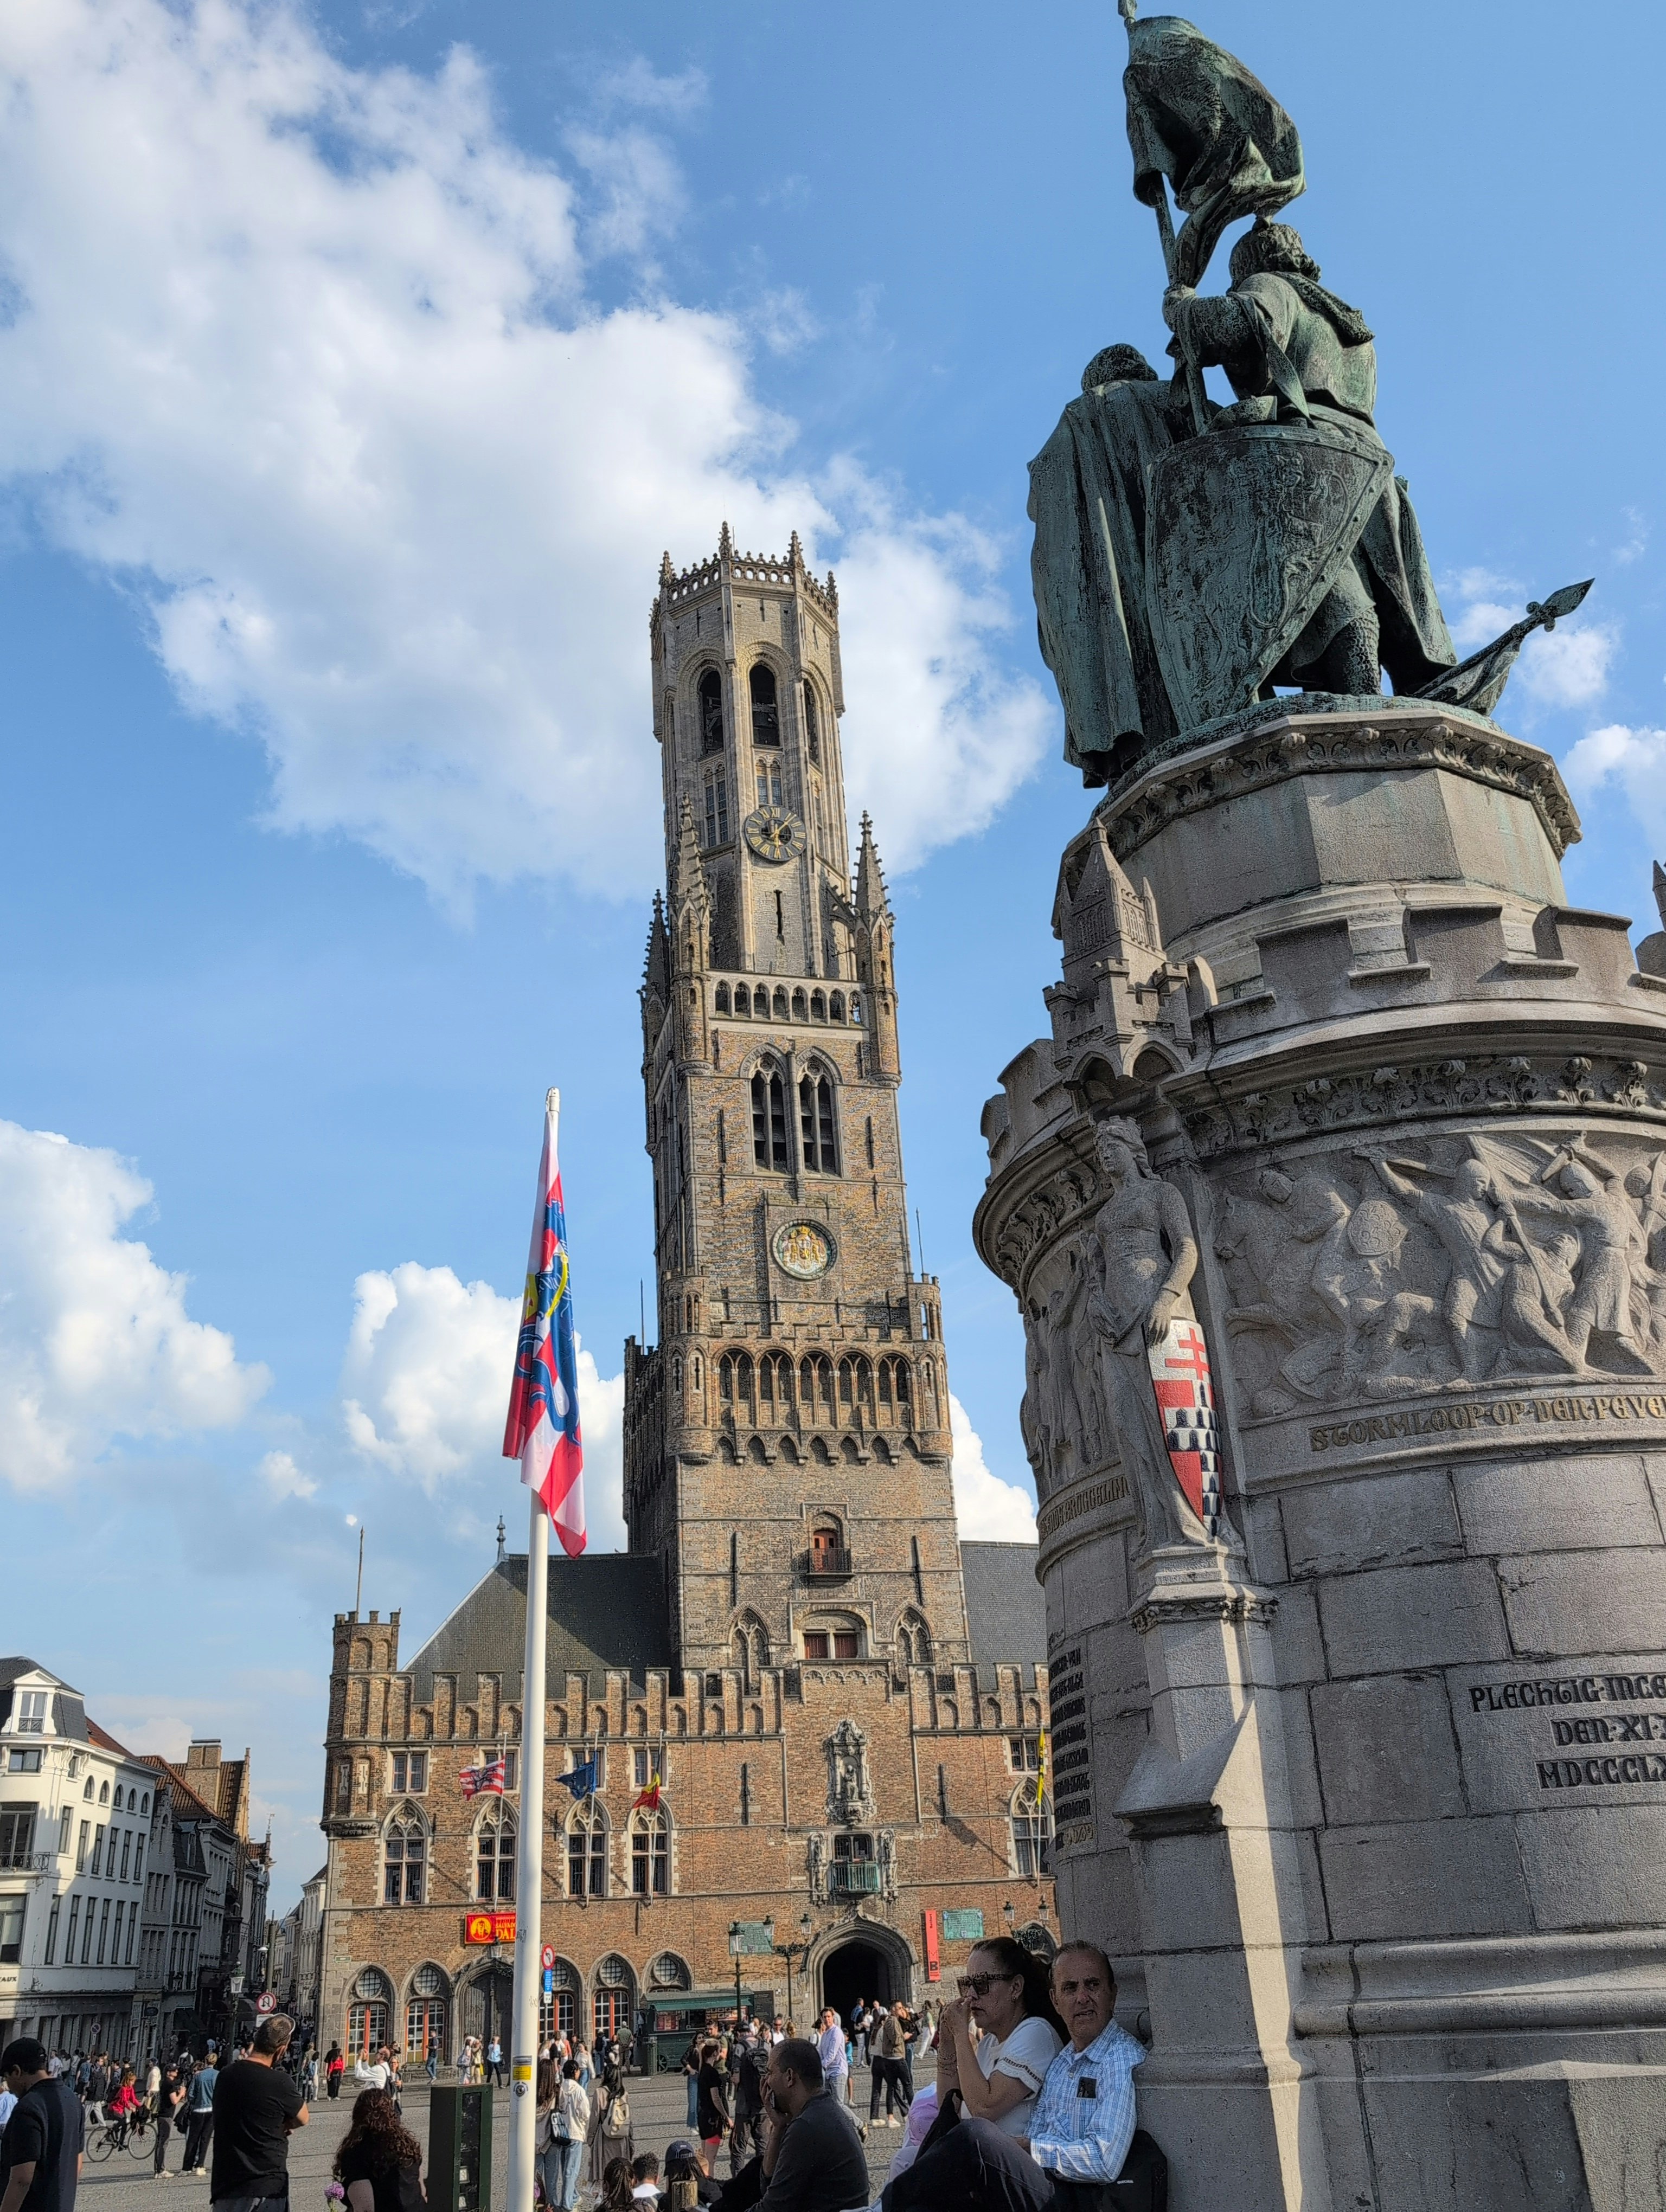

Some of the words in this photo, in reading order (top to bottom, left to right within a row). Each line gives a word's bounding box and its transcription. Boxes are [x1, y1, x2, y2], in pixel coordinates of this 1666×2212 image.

[1492, 1401, 1524, 1425] OP
[1534, 1398, 1593, 1422] DEN
[1551, 1718, 1614, 1746] DEN
[1618, 1715, 1655, 1741] XI
